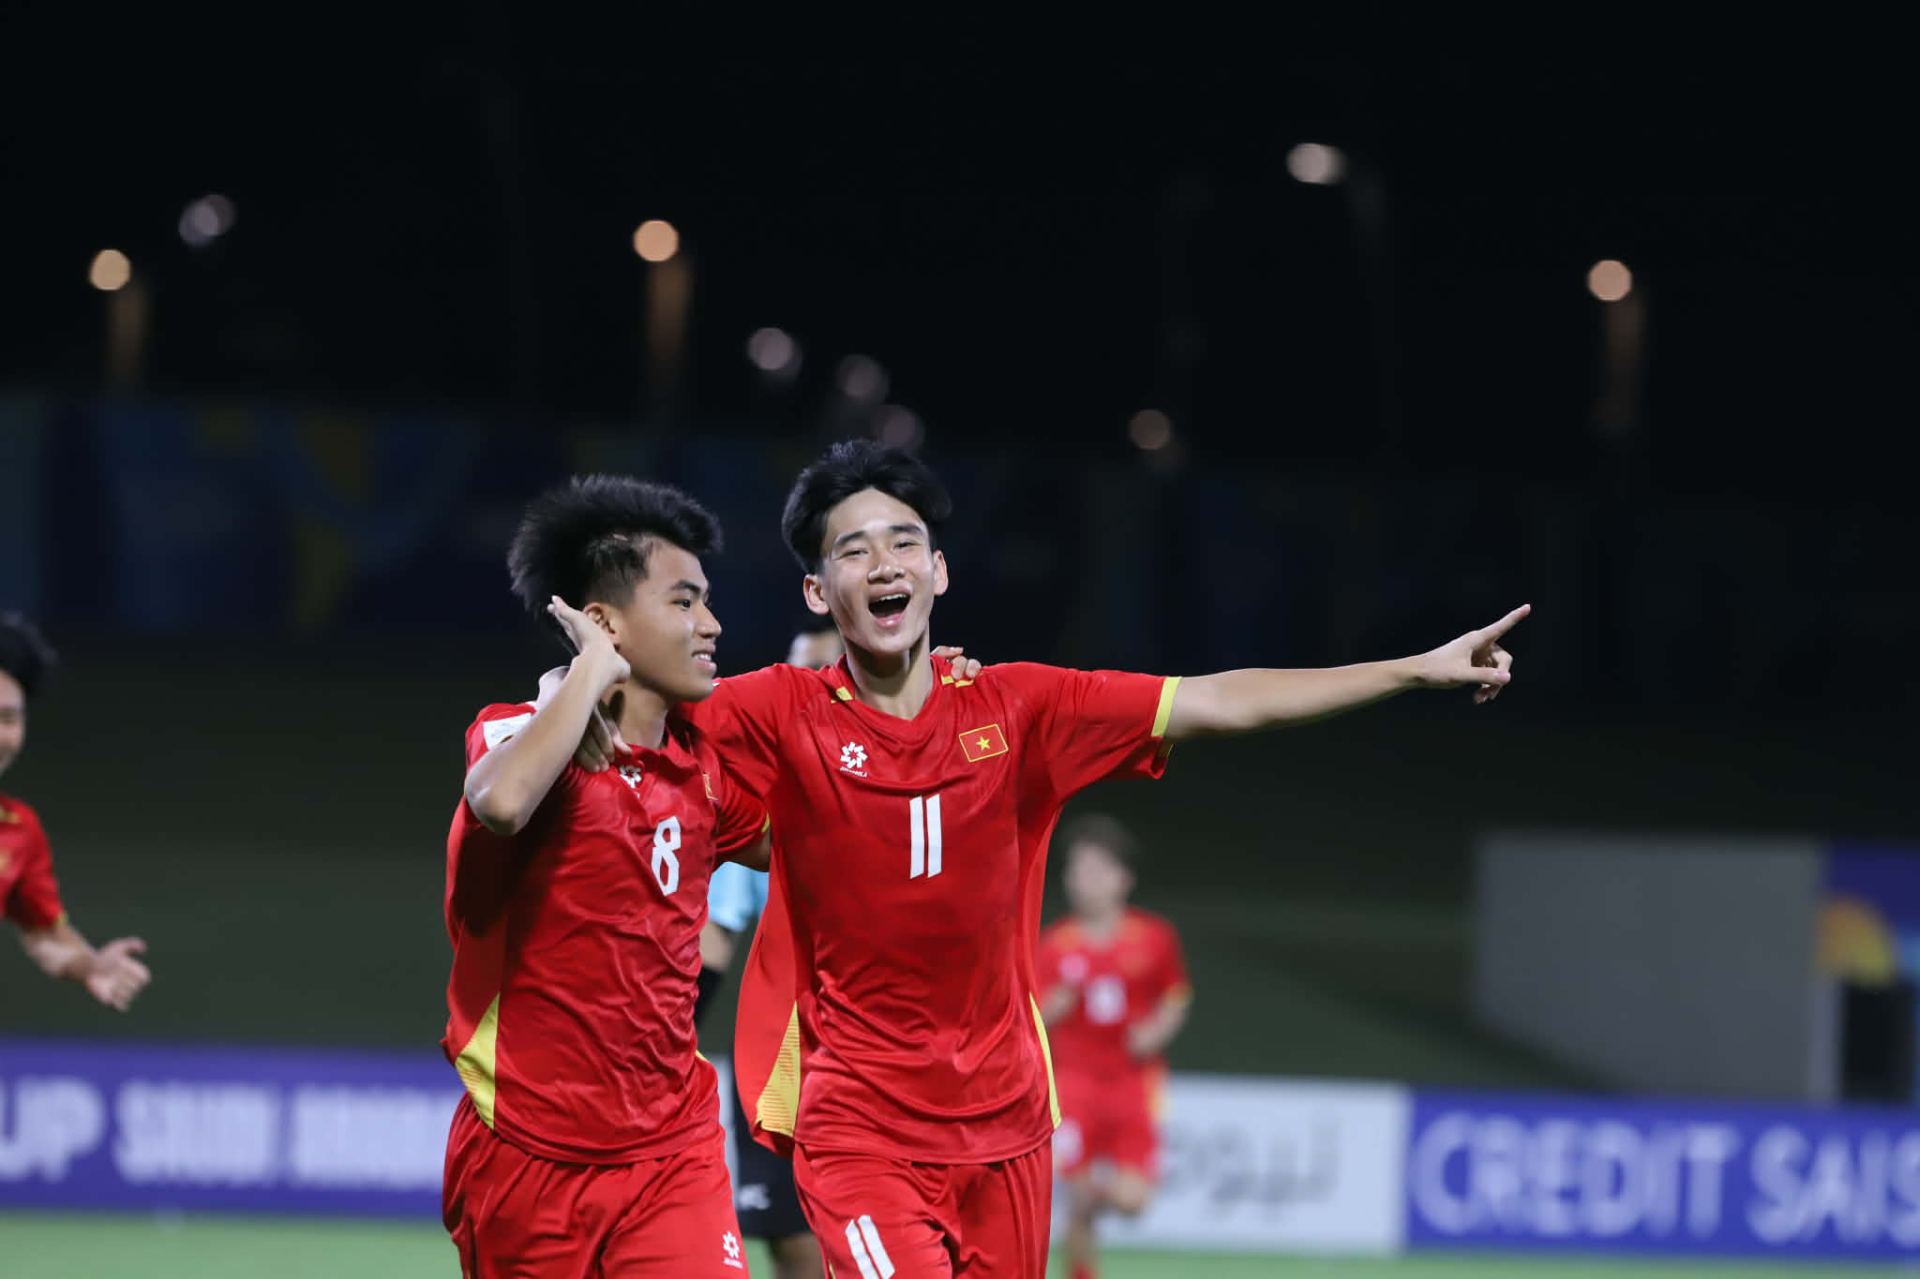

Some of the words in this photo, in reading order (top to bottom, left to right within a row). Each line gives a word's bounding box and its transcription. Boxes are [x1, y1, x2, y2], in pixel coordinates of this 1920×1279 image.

[650, 815, 682, 897] 8
[909, 793, 943, 880] 11
[1413, 1112, 1740, 1238] CREDIT
[845, 1214, 895, 1279] 11
